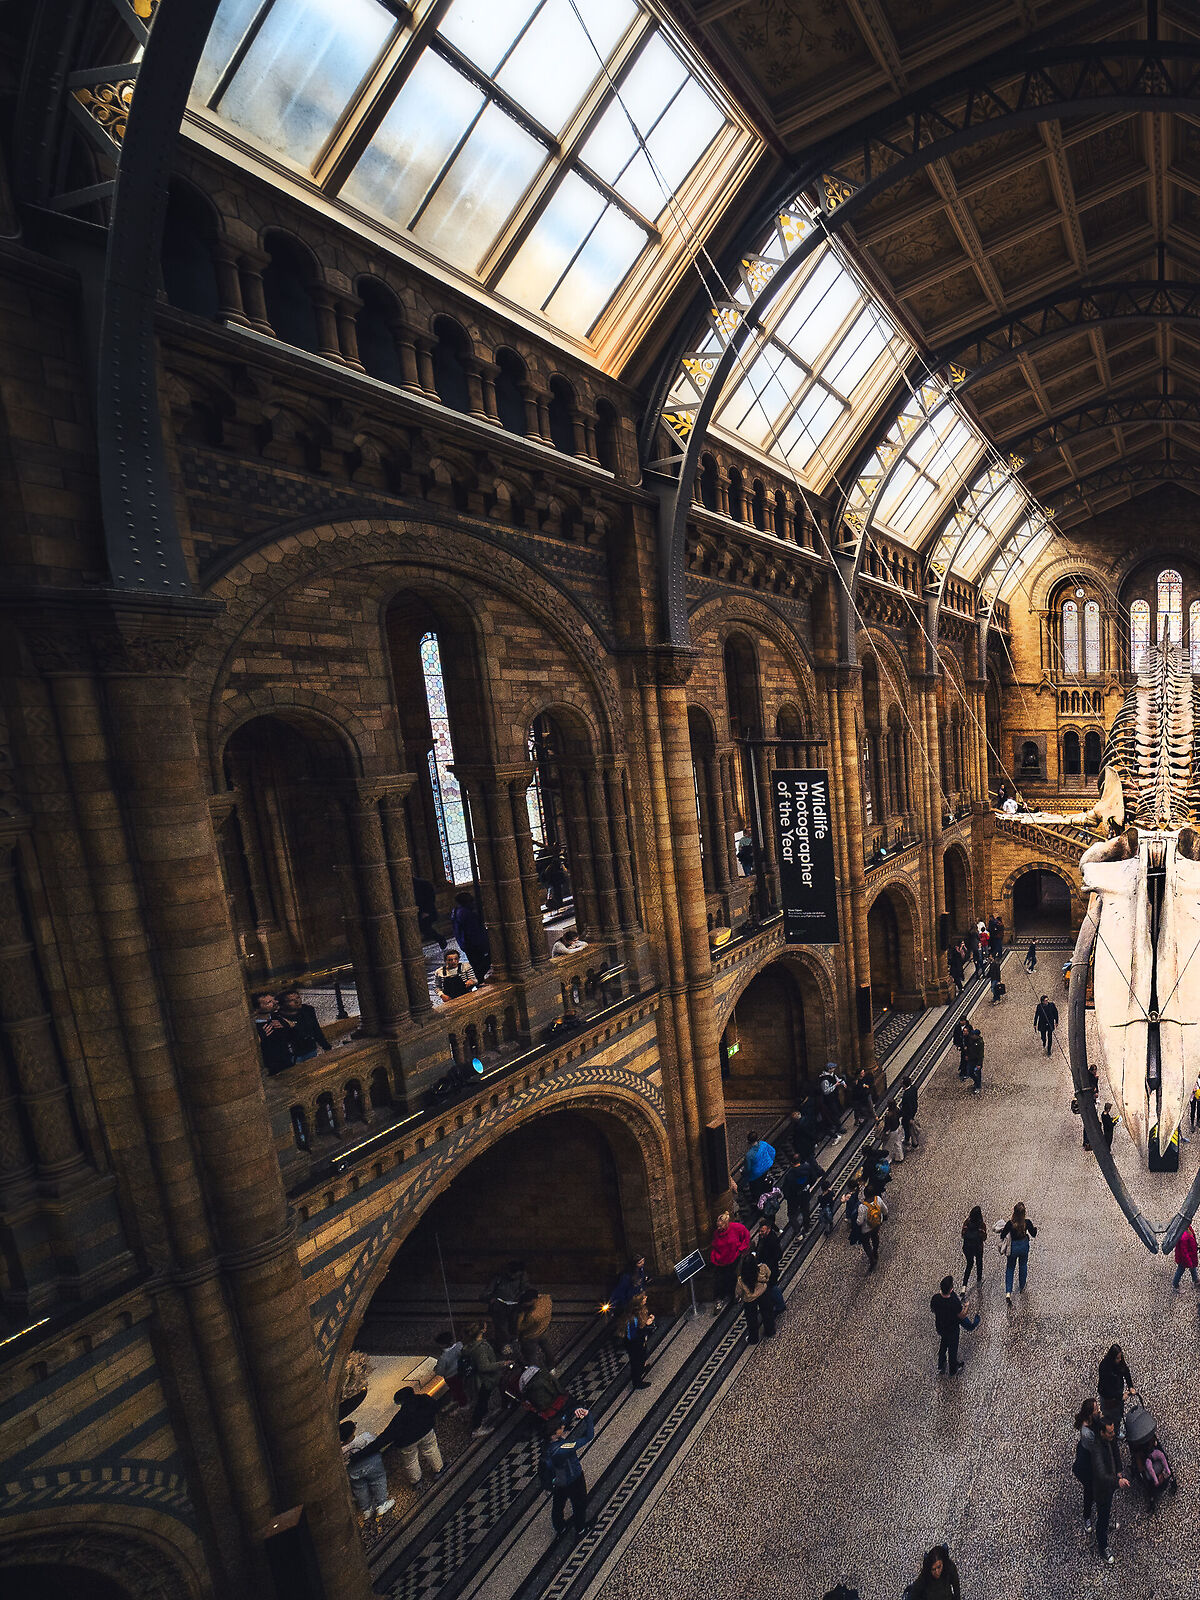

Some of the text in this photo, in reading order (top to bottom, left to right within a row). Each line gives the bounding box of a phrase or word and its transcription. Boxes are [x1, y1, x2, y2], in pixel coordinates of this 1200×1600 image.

[777, 781, 795, 864] of the Year
[794, 782, 814, 888] Photographer
[811, 781, 828, 839] Wildlife
